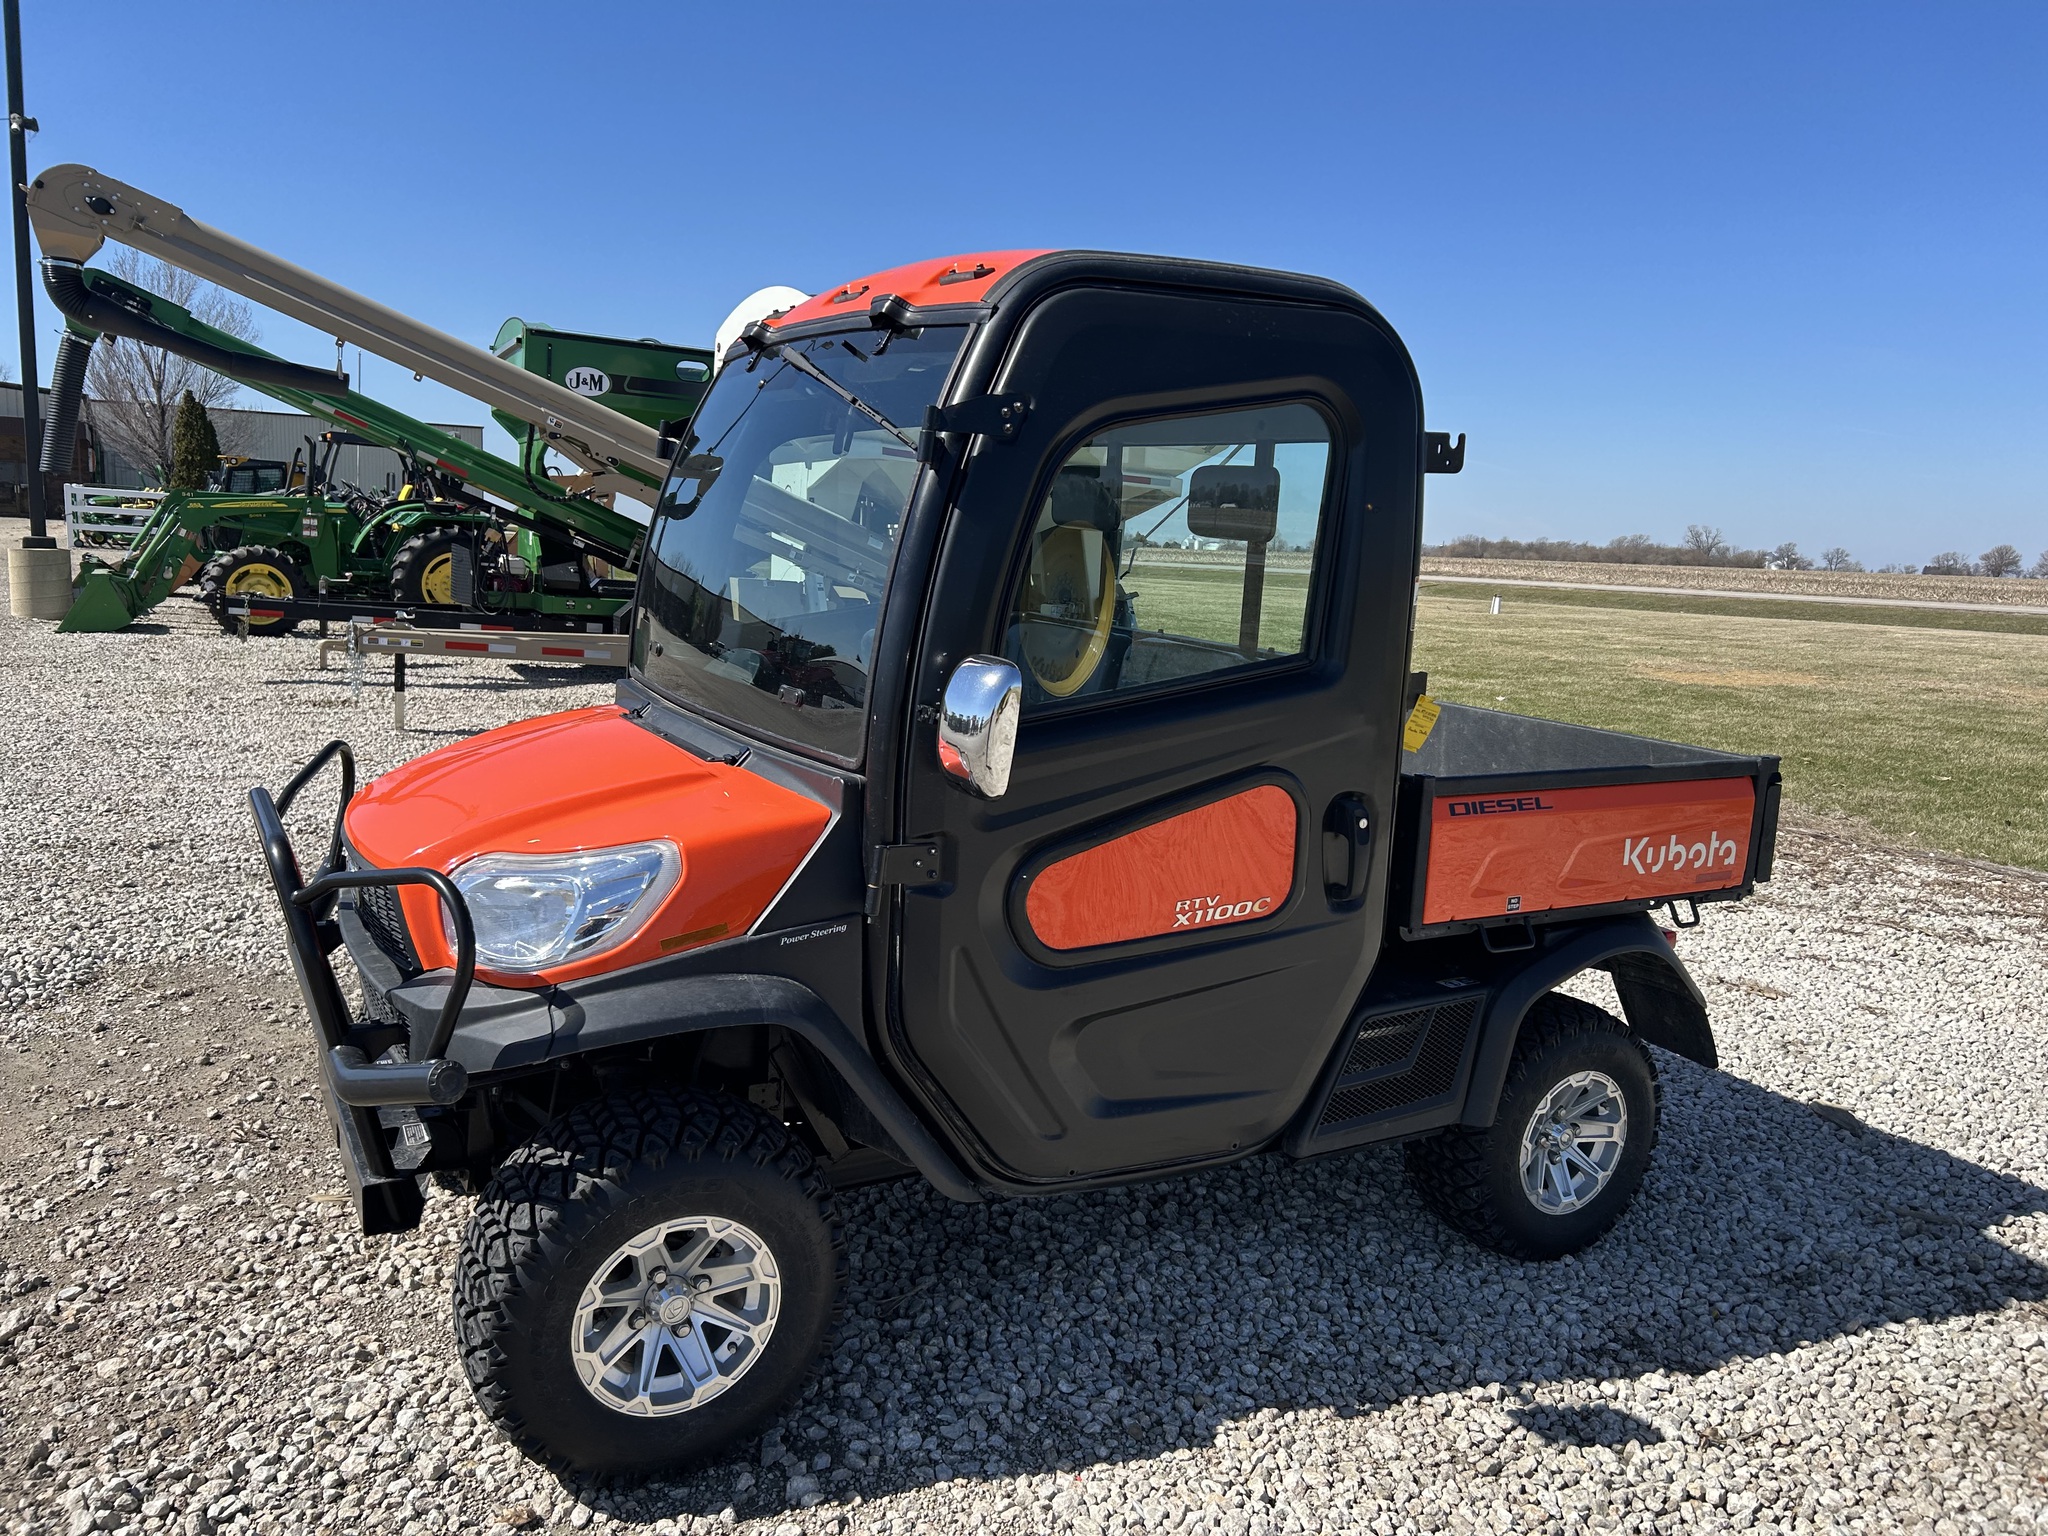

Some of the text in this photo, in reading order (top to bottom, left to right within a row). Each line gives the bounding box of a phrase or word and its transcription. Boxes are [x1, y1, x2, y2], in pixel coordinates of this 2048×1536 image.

[568, 371, 604, 392] J&M
[1448, 796, 1554, 817] DIESEL
[1623, 831, 1737, 874] Kubota
[1172, 897, 1271, 928] X1100C
[1175, 895, 1220, 912] RTV
[780, 924, 847, 946] Power Steering
